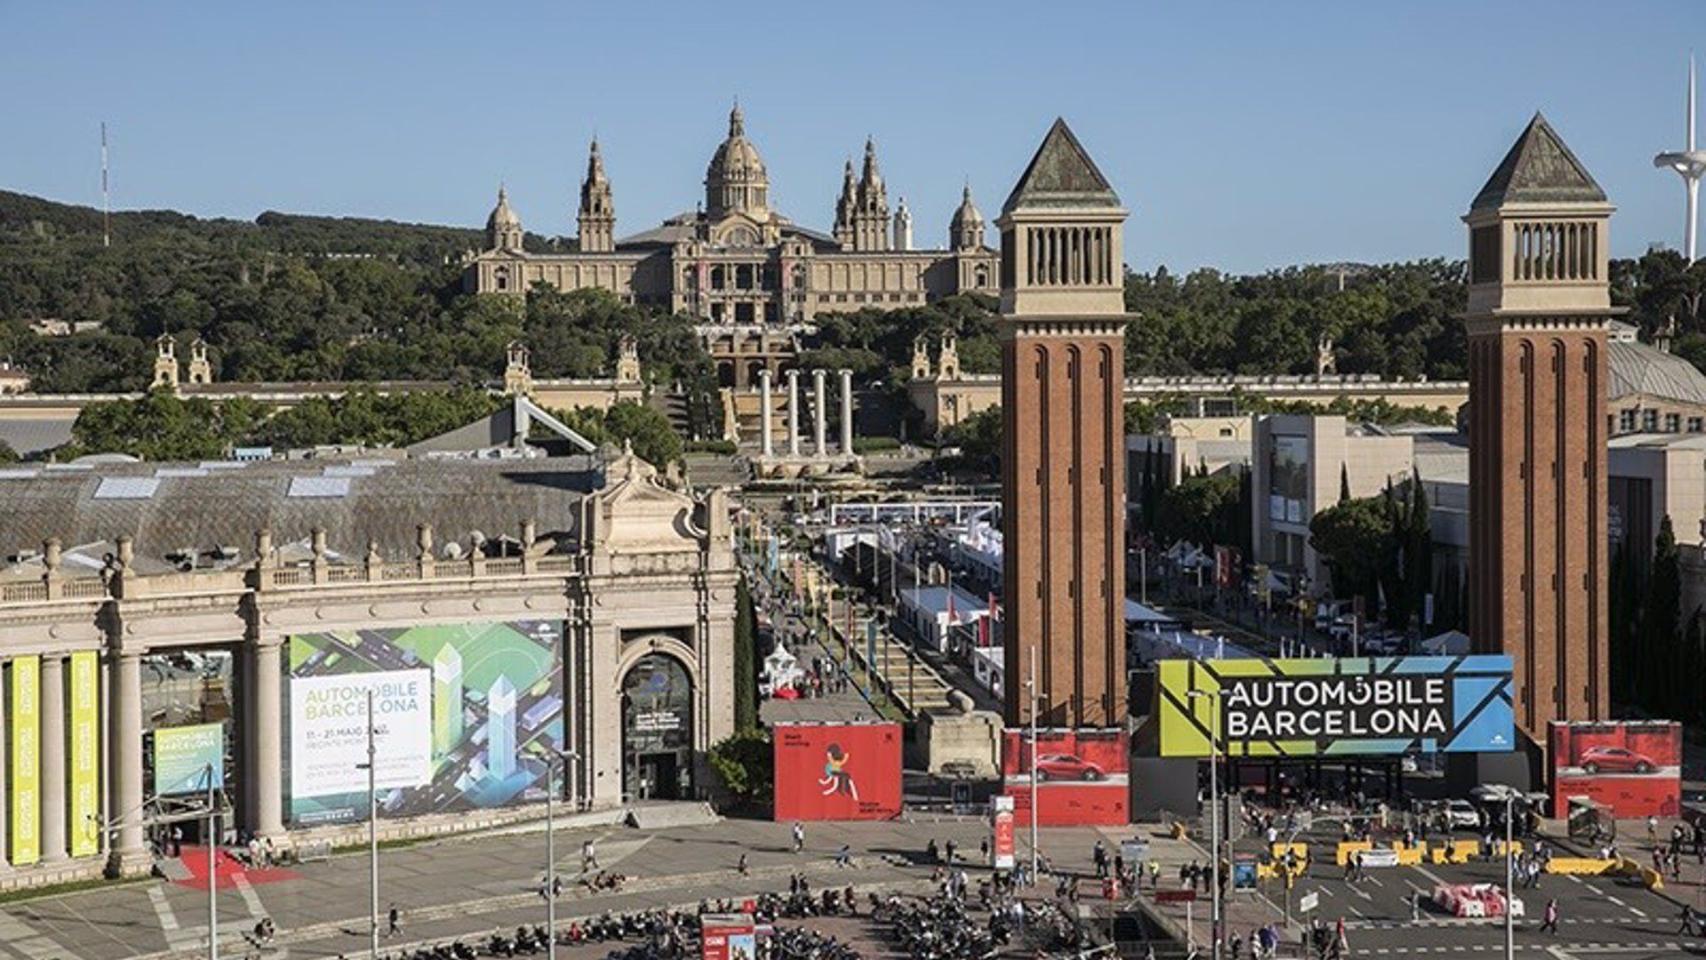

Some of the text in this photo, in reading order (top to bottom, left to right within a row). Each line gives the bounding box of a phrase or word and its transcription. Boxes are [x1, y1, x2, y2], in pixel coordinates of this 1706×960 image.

[305, 681, 418, 703] AUTOMOBILE
[1228, 677, 1445, 706] AUTOMOBILE
[1227, 709, 1446, 736] BARCELONA
